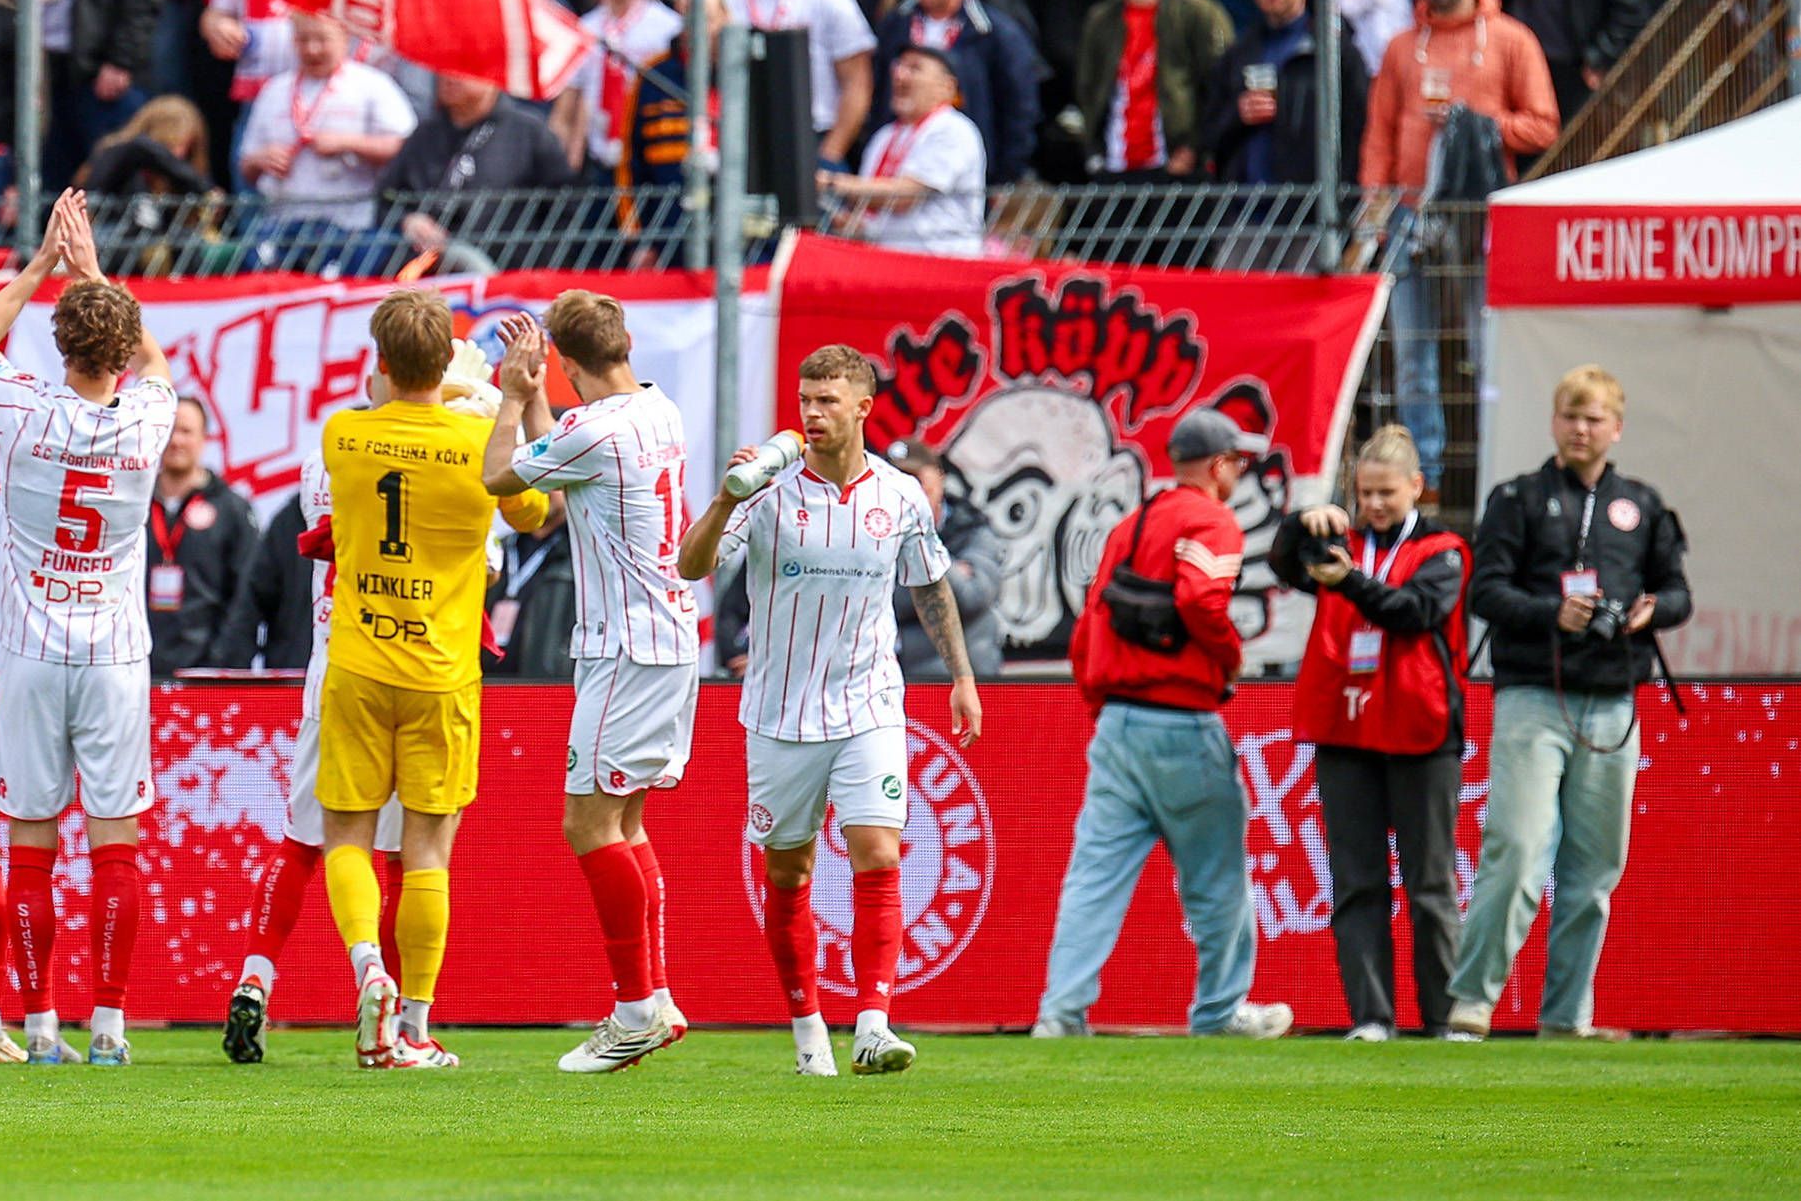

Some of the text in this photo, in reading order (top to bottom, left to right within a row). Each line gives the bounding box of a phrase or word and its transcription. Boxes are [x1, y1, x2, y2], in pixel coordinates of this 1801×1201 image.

[1556, 217, 1666, 281] KEINE
[32, 443, 150, 471] S.C. FORTUNA KÖLN
[337, 436, 470, 466] S.C. FORTUNA KÖLN
[54, 469, 115, 554] 5
[376, 470, 414, 565] 1
[803, 564, 862, 578] Lebenshilfe
[356, 572, 434, 601] WINKLER
